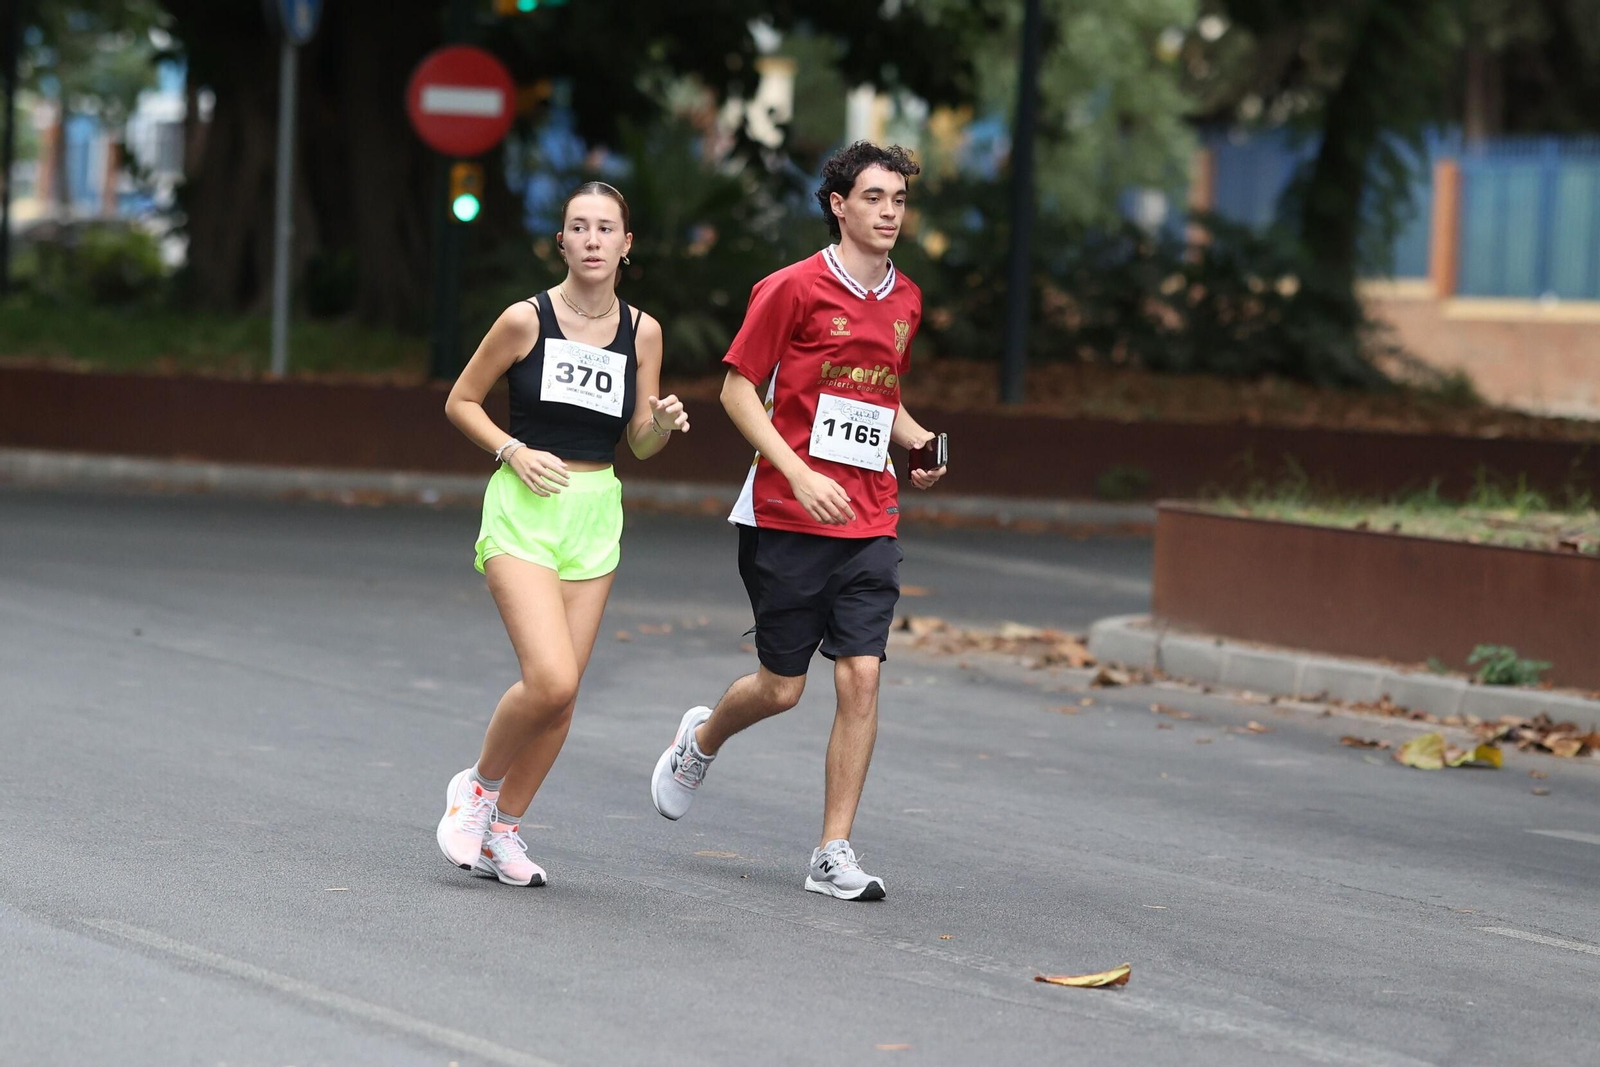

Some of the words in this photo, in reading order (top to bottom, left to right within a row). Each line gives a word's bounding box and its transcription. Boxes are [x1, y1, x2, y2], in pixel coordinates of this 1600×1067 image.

[555, 362, 613, 393] 370
[820, 360, 897, 389] tenerife
[823, 418, 881, 447] 1165
